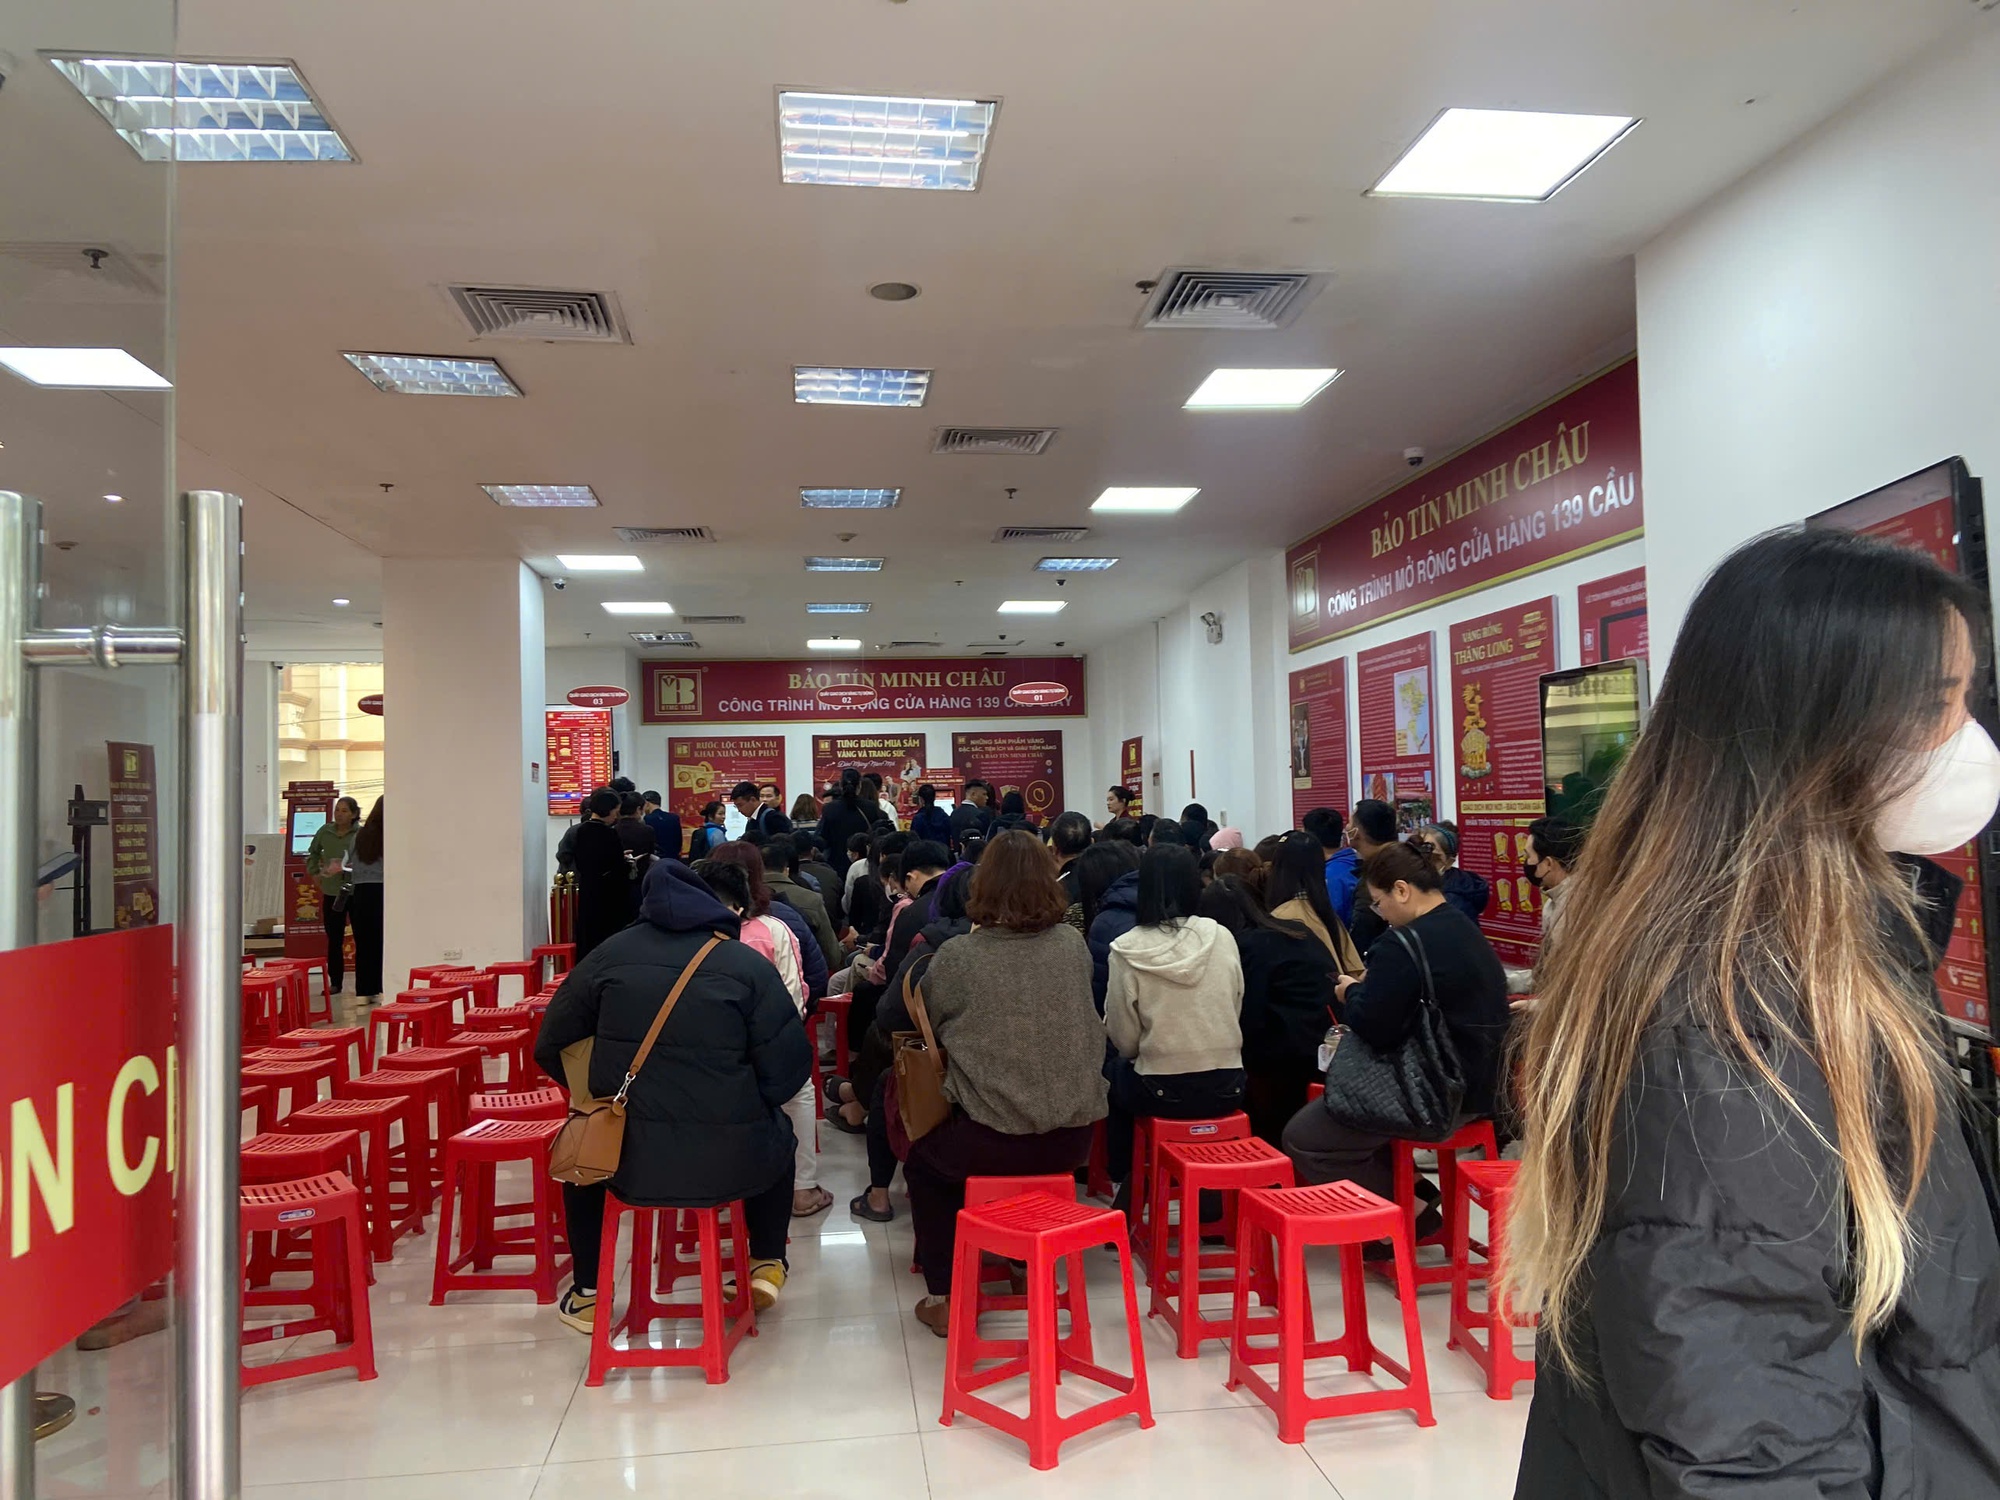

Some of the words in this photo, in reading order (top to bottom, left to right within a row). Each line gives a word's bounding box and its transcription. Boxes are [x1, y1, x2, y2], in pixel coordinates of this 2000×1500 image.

[1370, 509, 1404, 559] BẢO
[1407, 496, 1441, 541] TÍN
[1446, 462, 1508, 523] MINH
[1513, 420, 1590, 491] CHÂU
[1327, 587, 1357, 618] CÔNG
[1358, 567, 1392, 605] TRÌNH
[1395, 555, 1415, 591] MỞ
[1417, 546, 1456, 586] RỘNG
[1460, 527, 1492, 566] CỬA
[1496, 515, 1546, 555] HÀNG
[1551, 494, 1584, 532] 139
[1588, 466, 1636, 517] CẦU
[1486, 638, 1514, 658] LONG
[788, 667, 831, 690] BẢO
[836, 668, 876, 688] TÍN
[880, 671, 942, 688] MINH
[945, 667, 1007, 687] CHÂU
[718, 697, 764, 713] CÔNG
[767, 697, 814, 712] TRÌNH
[893, 693, 925, 710] CỬA
[929, 694, 972, 709] HÀNG
[976, 696, 1000, 708] 139
[841, 696, 852, 704] 02
[884, 738, 902, 747] MUA
[836, 749, 856, 758] VÀNG
[857, 749, 868, 758] VÀ
[868, 750, 892, 758] TRANG
[0, 1082, 75, 1259] N
